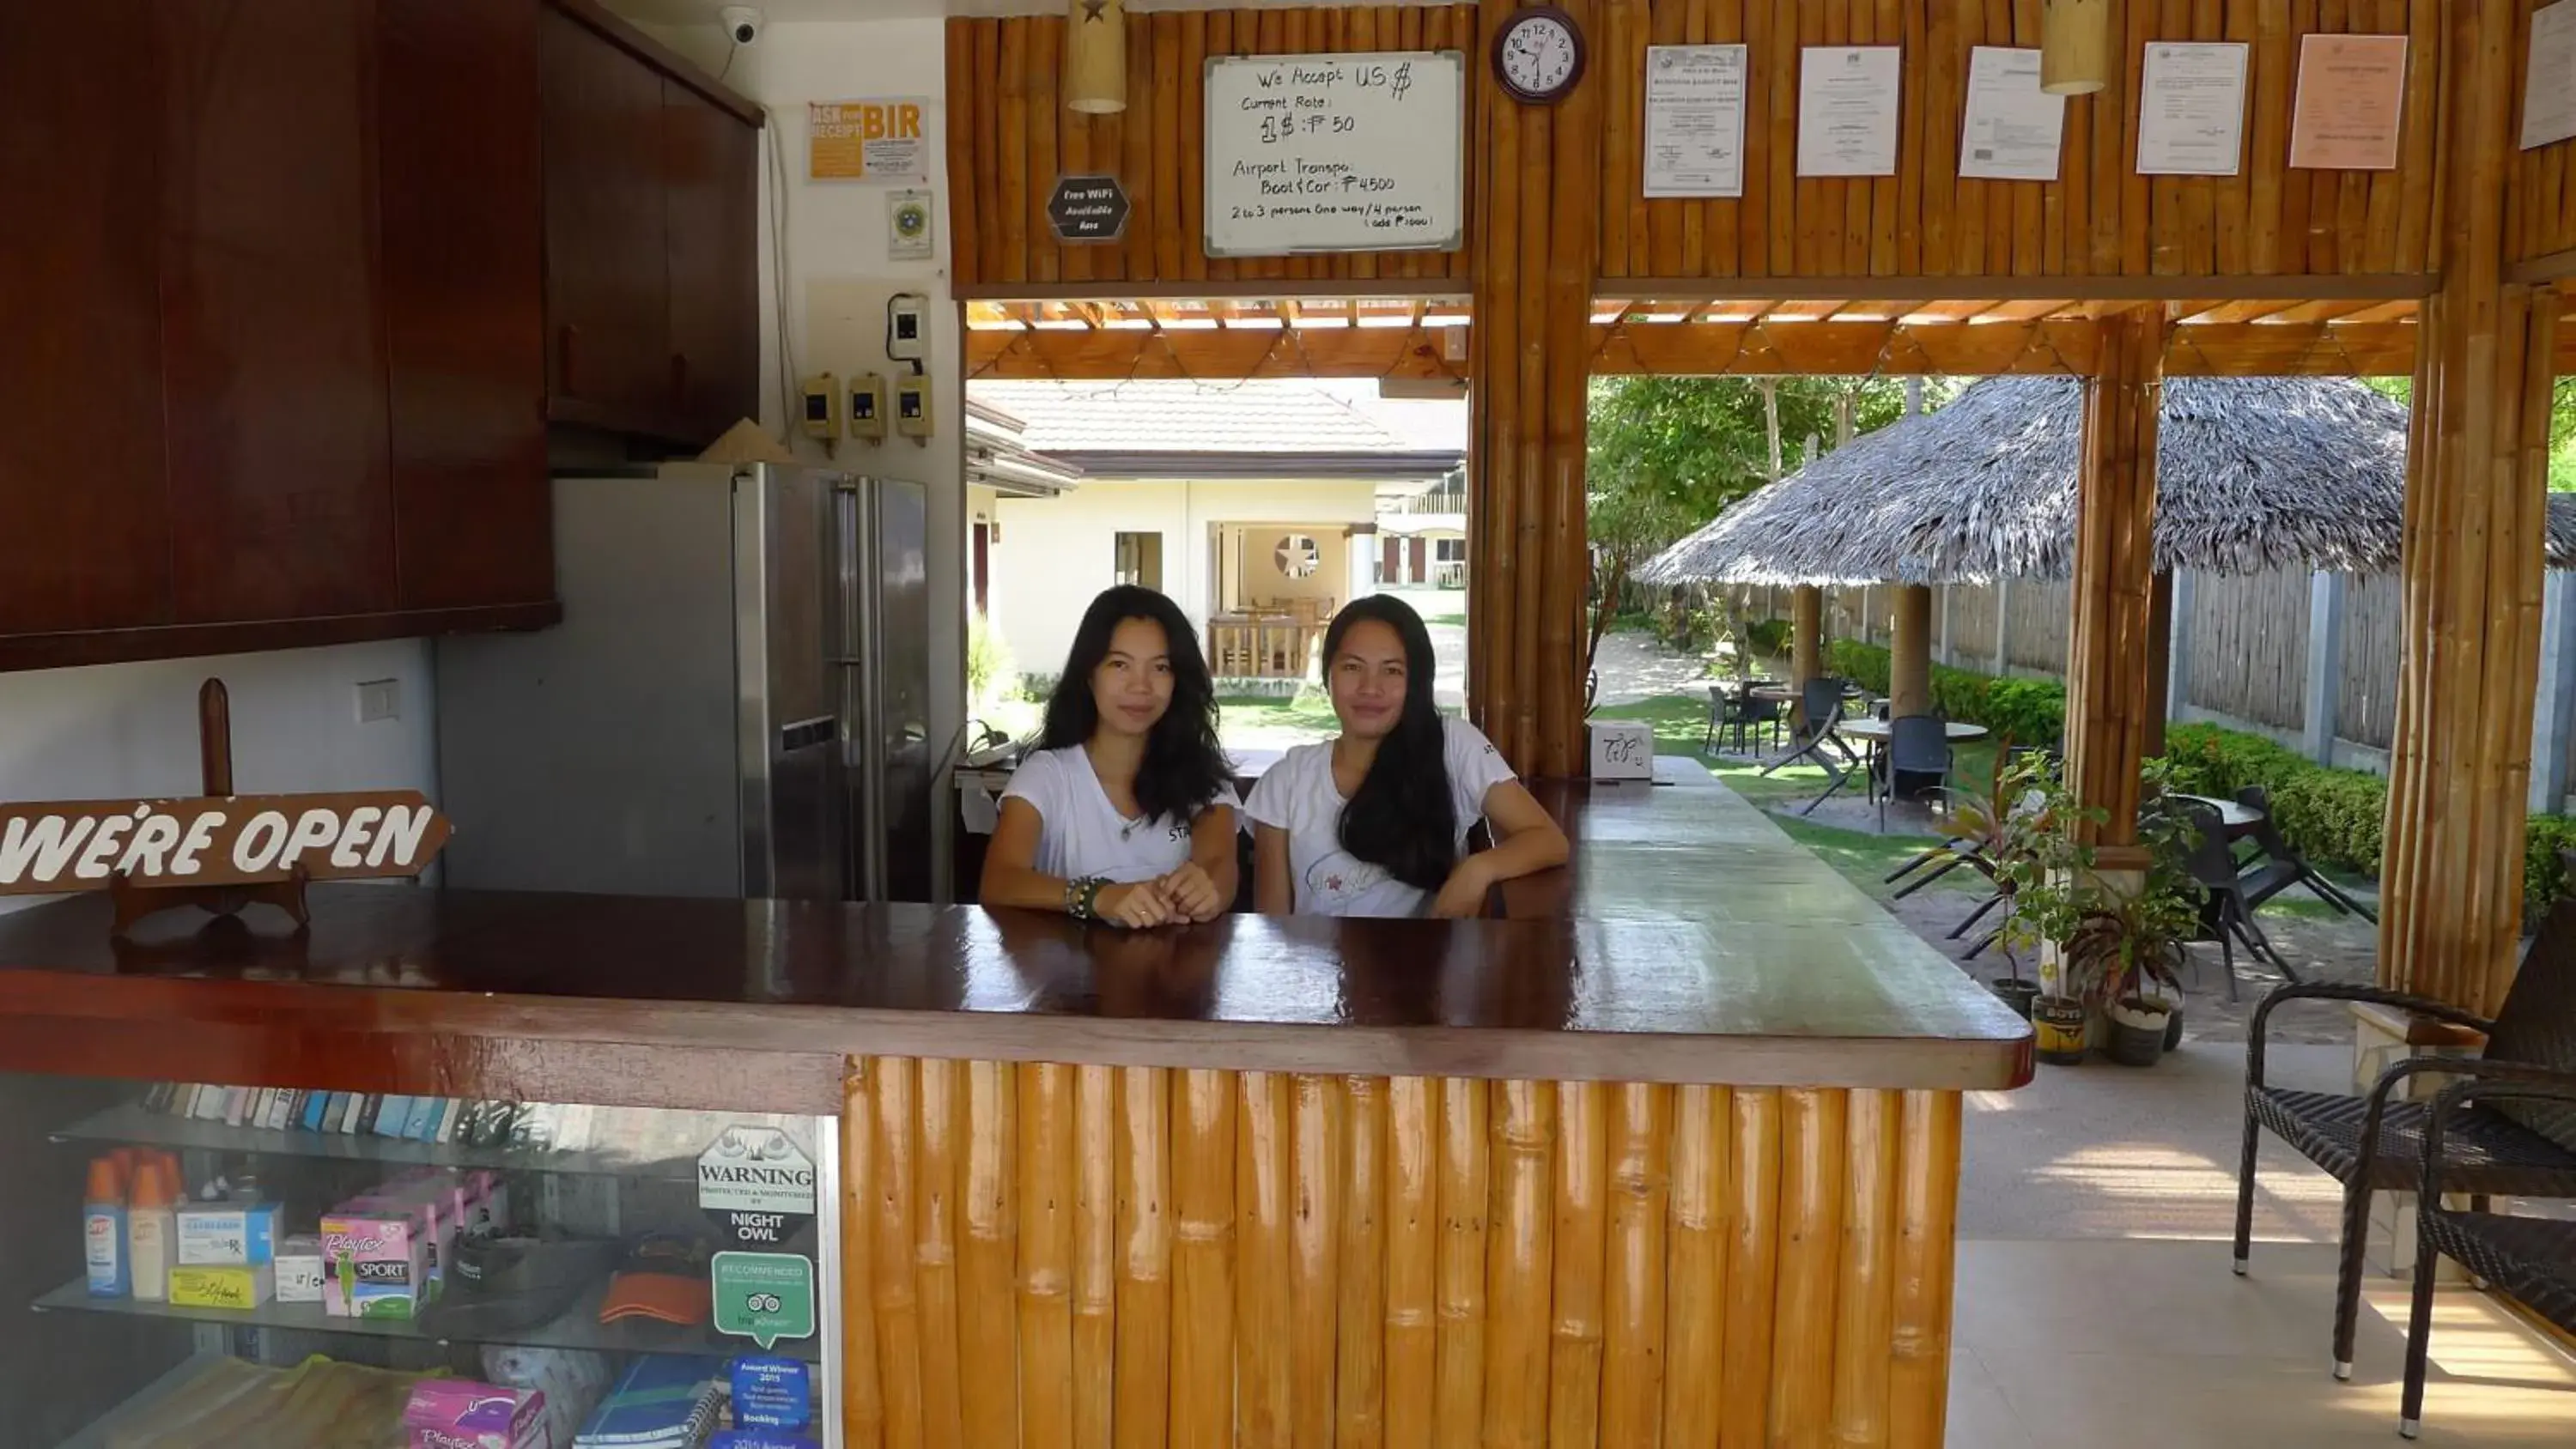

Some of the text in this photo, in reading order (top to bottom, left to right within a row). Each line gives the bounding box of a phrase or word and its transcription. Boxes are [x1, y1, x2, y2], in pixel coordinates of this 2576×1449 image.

[1533, 24, 1546, 34] 12
[1511, 38, 1522, 48] 10
[1558, 38, 1565, 48] 2
[1562, 52, 1569, 62] 3
[1256, 69, 1283, 88] We
[1291, 66, 1344, 88] Accept
[1356, 66, 1386, 86] US
[1555, 66, 1562, 76] 4
[1241, 96, 1287, 110] Current
[864, 104, 920, 138] BIR
[1232, 159, 1287, 179] Airport
[1064, 190, 1085, 200] Free
[1231, 207, 1241, 220] 2
[1257, 205, 1265, 217] 3
[0, 803, 434, 884] WE'RE OPEN
[700, 1164, 812, 1185] WARNING
[731, 1212, 784, 1228] NIGHT
[738, 1227, 779, 1241] OWL
[325, 1234, 386, 1256] Playtex
[360, 1263, 407, 1278] SPORT
[721, 1264, 803, 1277] RECOMMENDED
